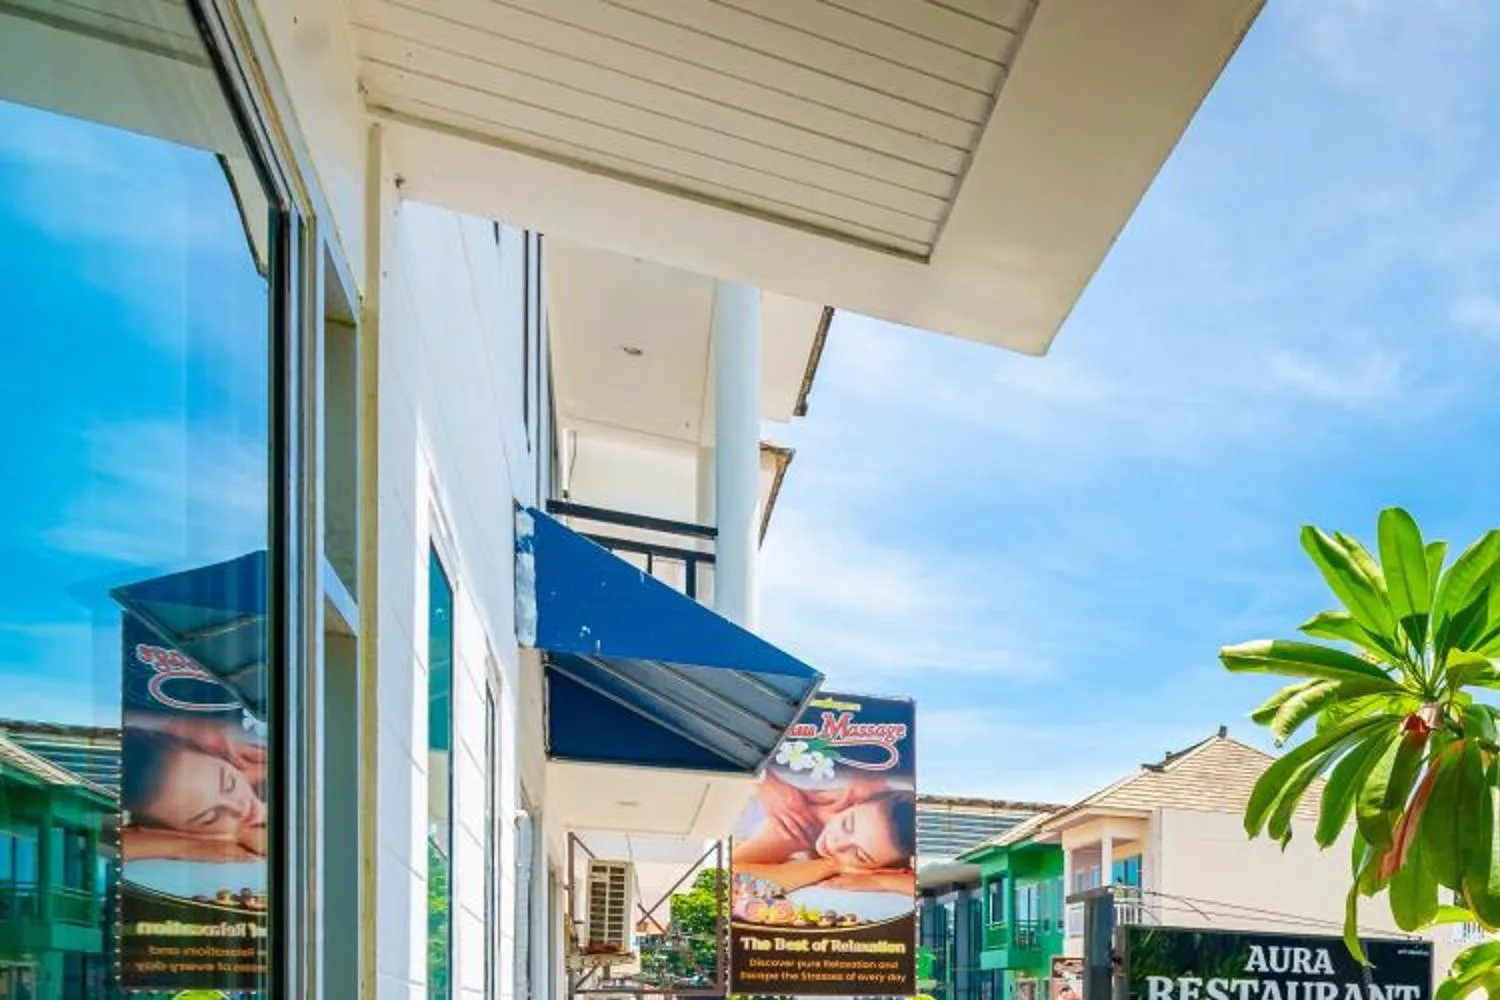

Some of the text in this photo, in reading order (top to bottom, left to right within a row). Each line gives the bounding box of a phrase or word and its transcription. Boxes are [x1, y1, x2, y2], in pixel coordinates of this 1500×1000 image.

[821, 711, 907, 747] Massage
[739, 936, 906, 954] The Best of Relaxation
[1243, 945, 1335, 975] AURA
